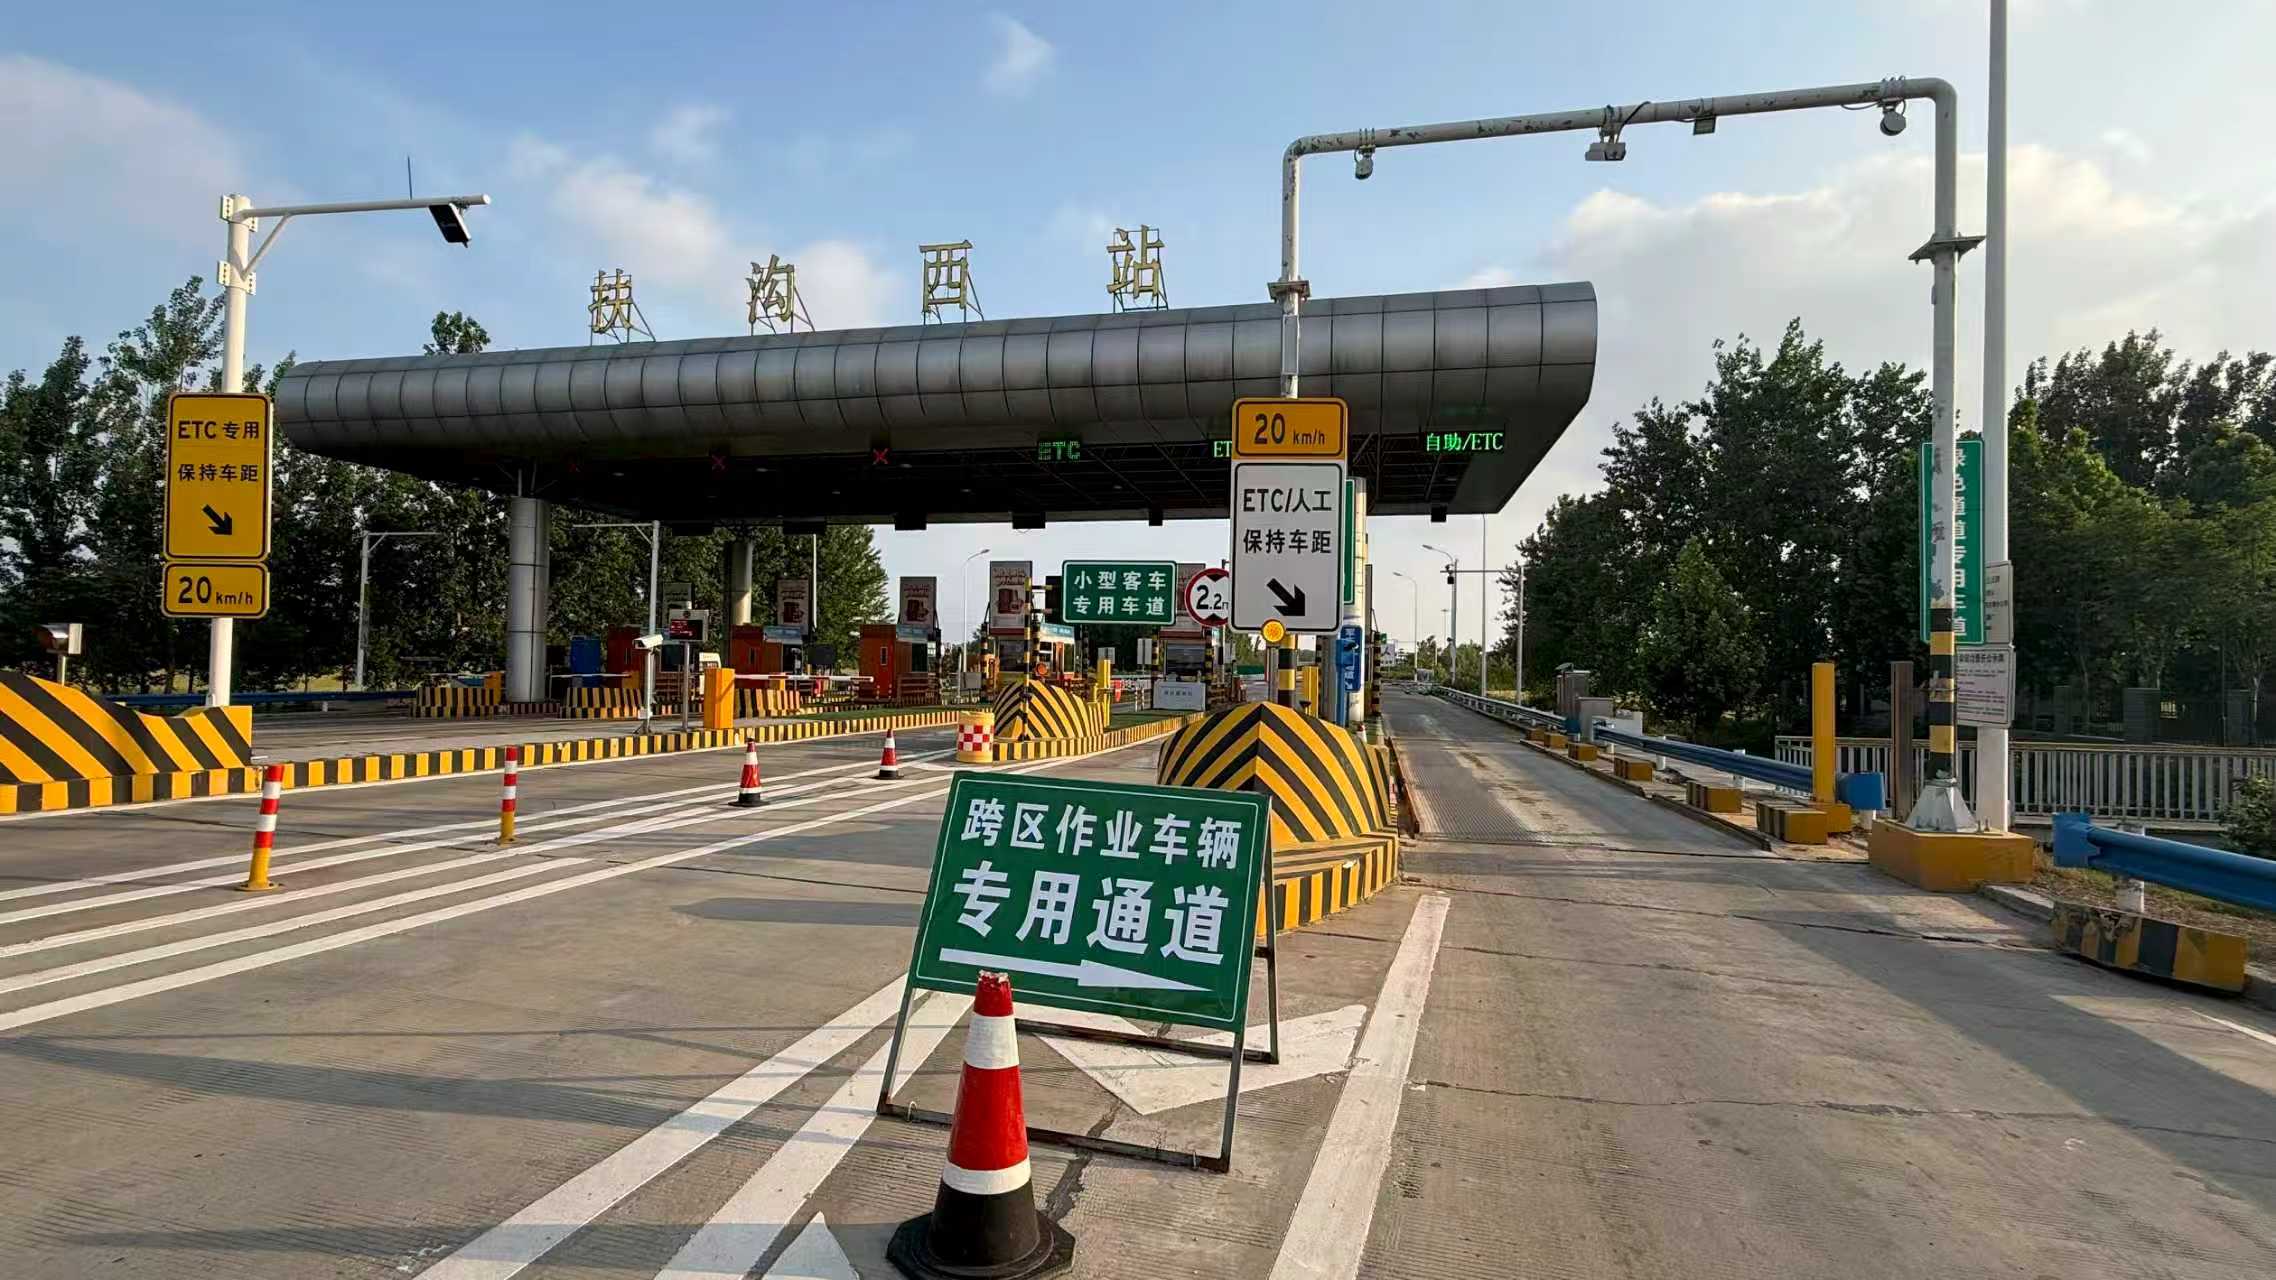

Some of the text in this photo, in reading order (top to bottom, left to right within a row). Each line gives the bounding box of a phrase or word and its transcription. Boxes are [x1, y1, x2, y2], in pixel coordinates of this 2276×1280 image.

[587, 225, 1165, 334] 扶沟西站
[178, 421, 260, 439] ETC 专用
[1254, 413, 1325, 446] 20 km/h
[1038, 440, 1081, 461] ETC
[1426, 432, 1504, 453] 自助/ETC
[178, 463, 259, 482] 保持车距
[1243, 488, 1332, 513] ETC/人工
[1243, 528, 1332, 554] 保持车距
[178, 576, 254, 606] 20 km/h
[1073, 571, 1167, 591] 小型客车
[1073, 596, 1165, 616] 专用车道
[961, 797, 1242, 870] 跨区作业车辆
[954, 860, 1229, 965] 专用通道
